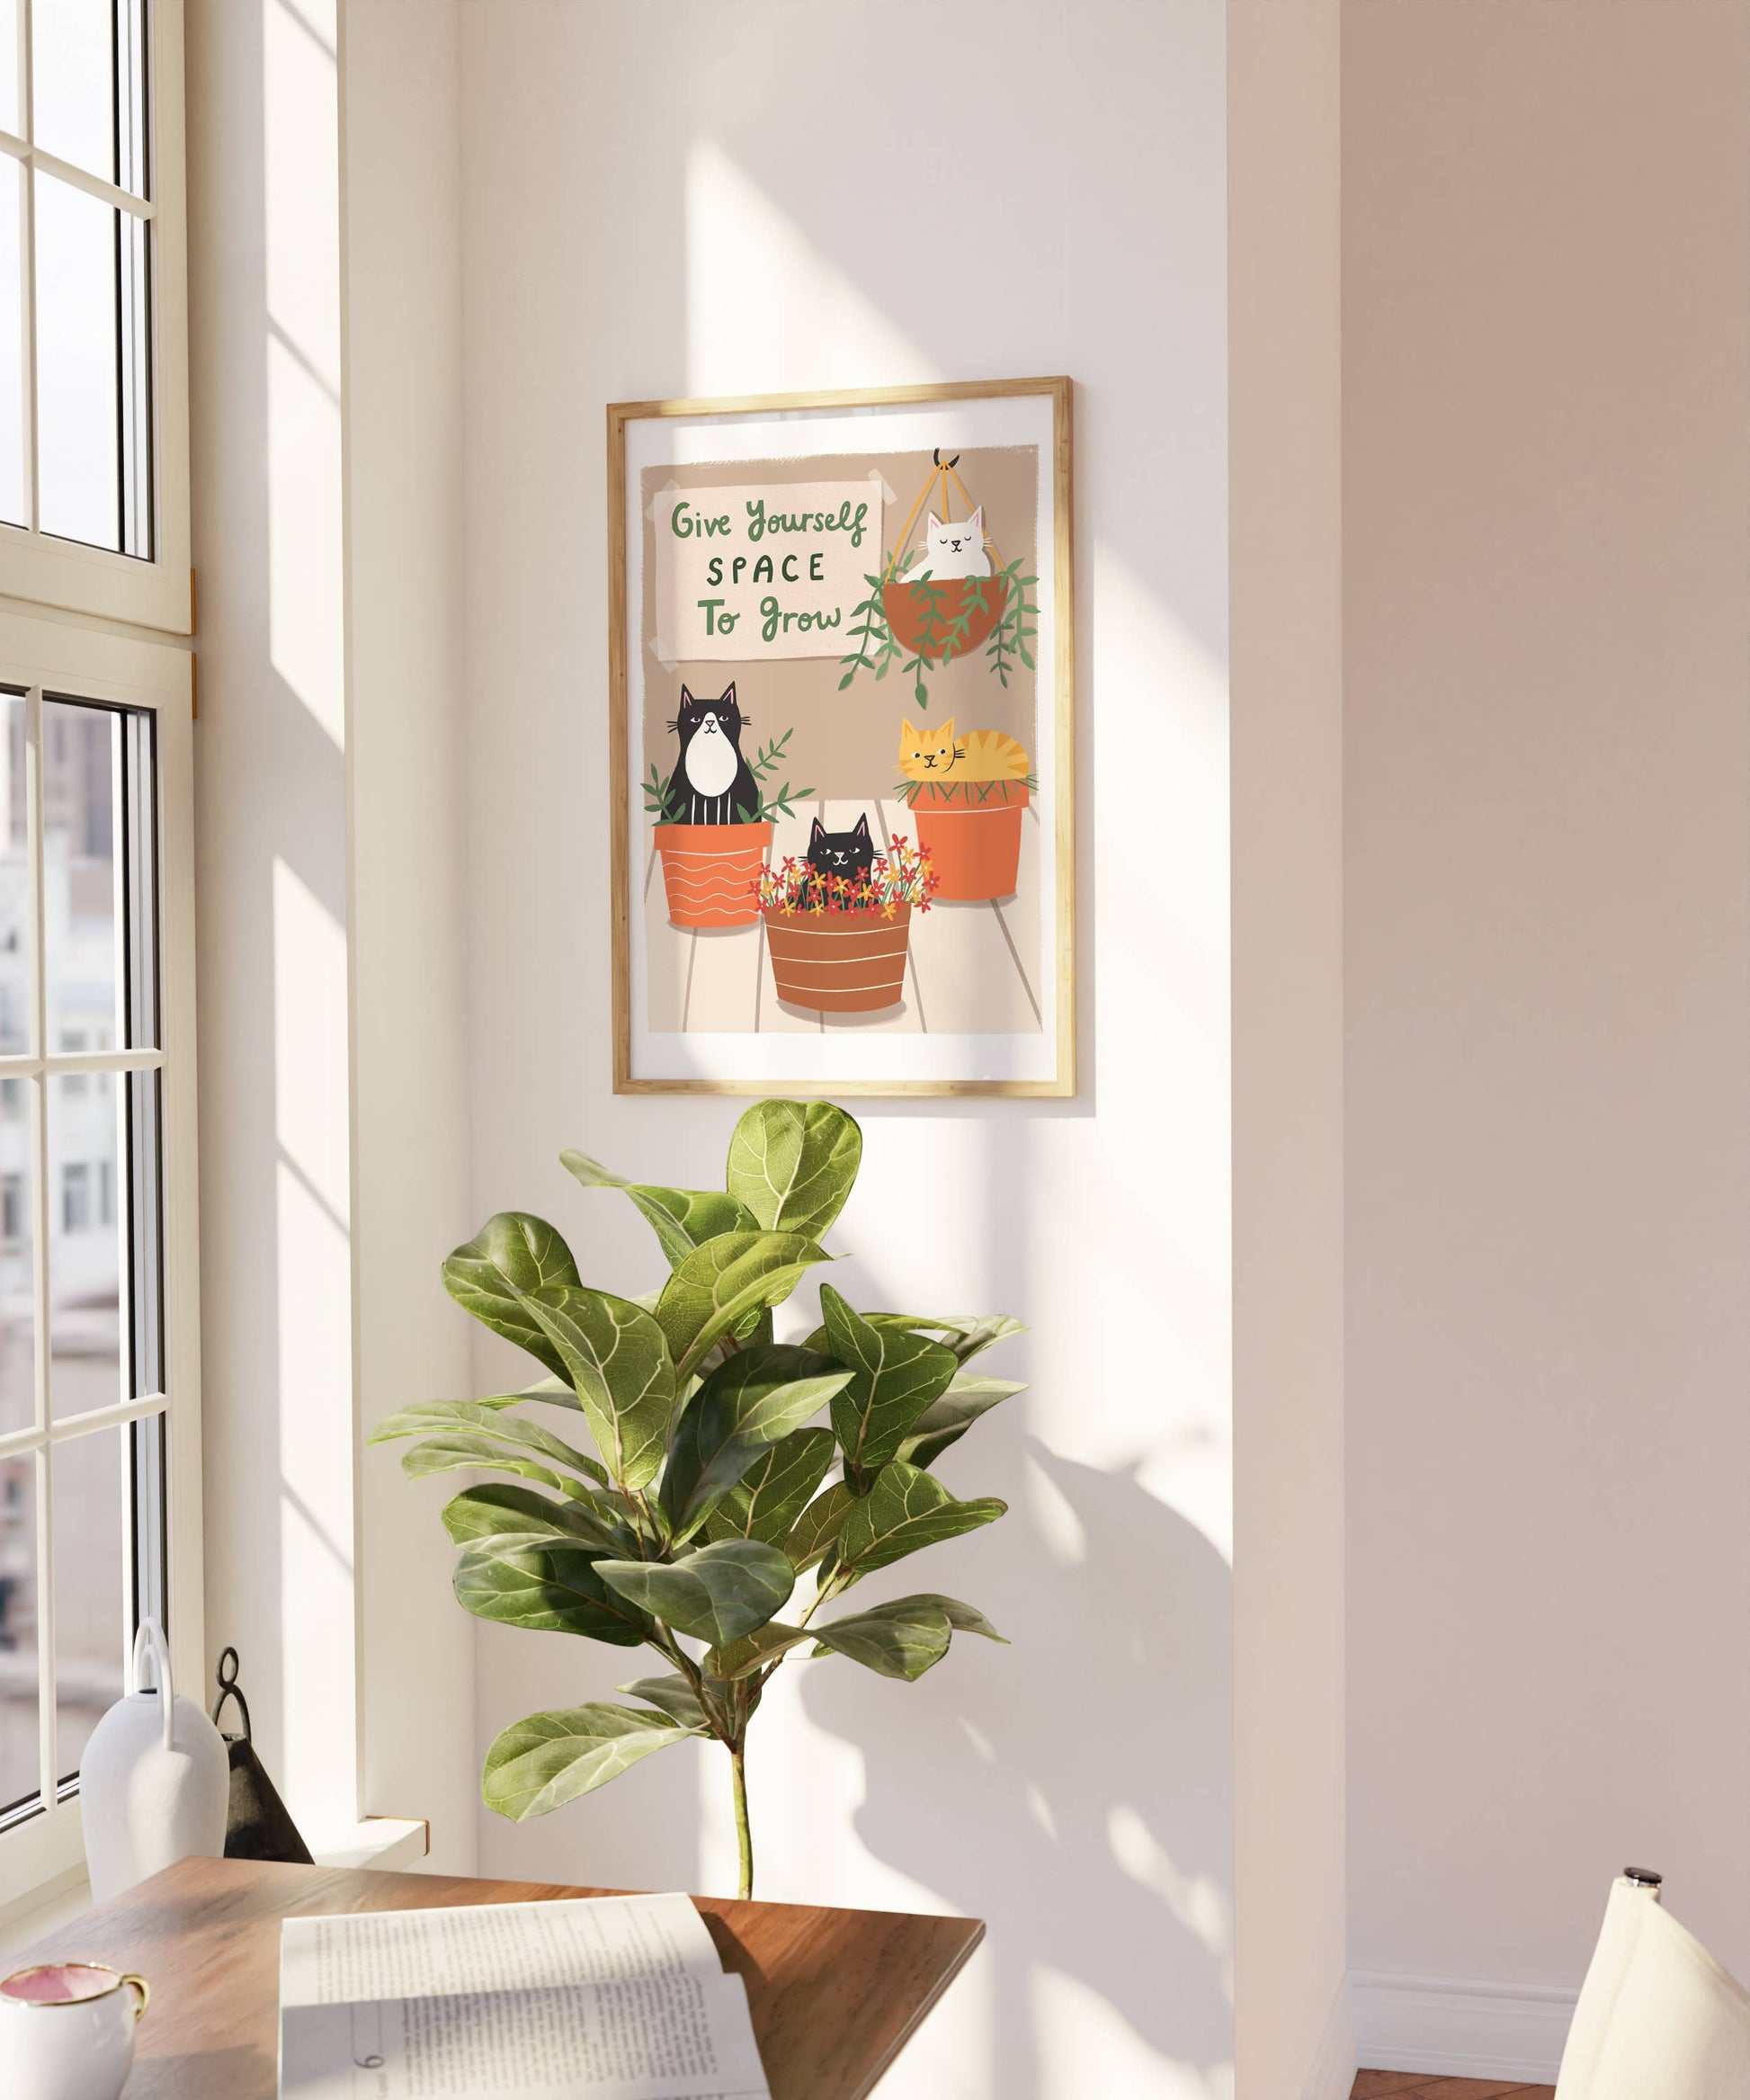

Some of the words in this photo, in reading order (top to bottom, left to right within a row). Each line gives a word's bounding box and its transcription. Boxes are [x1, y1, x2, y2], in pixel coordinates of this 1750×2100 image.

[672, 501, 731, 538] Give
[746, 499, 868, 548] Yourself
[706, 552, 824, 586] SPACE
[697, 598, 740, 636] To
